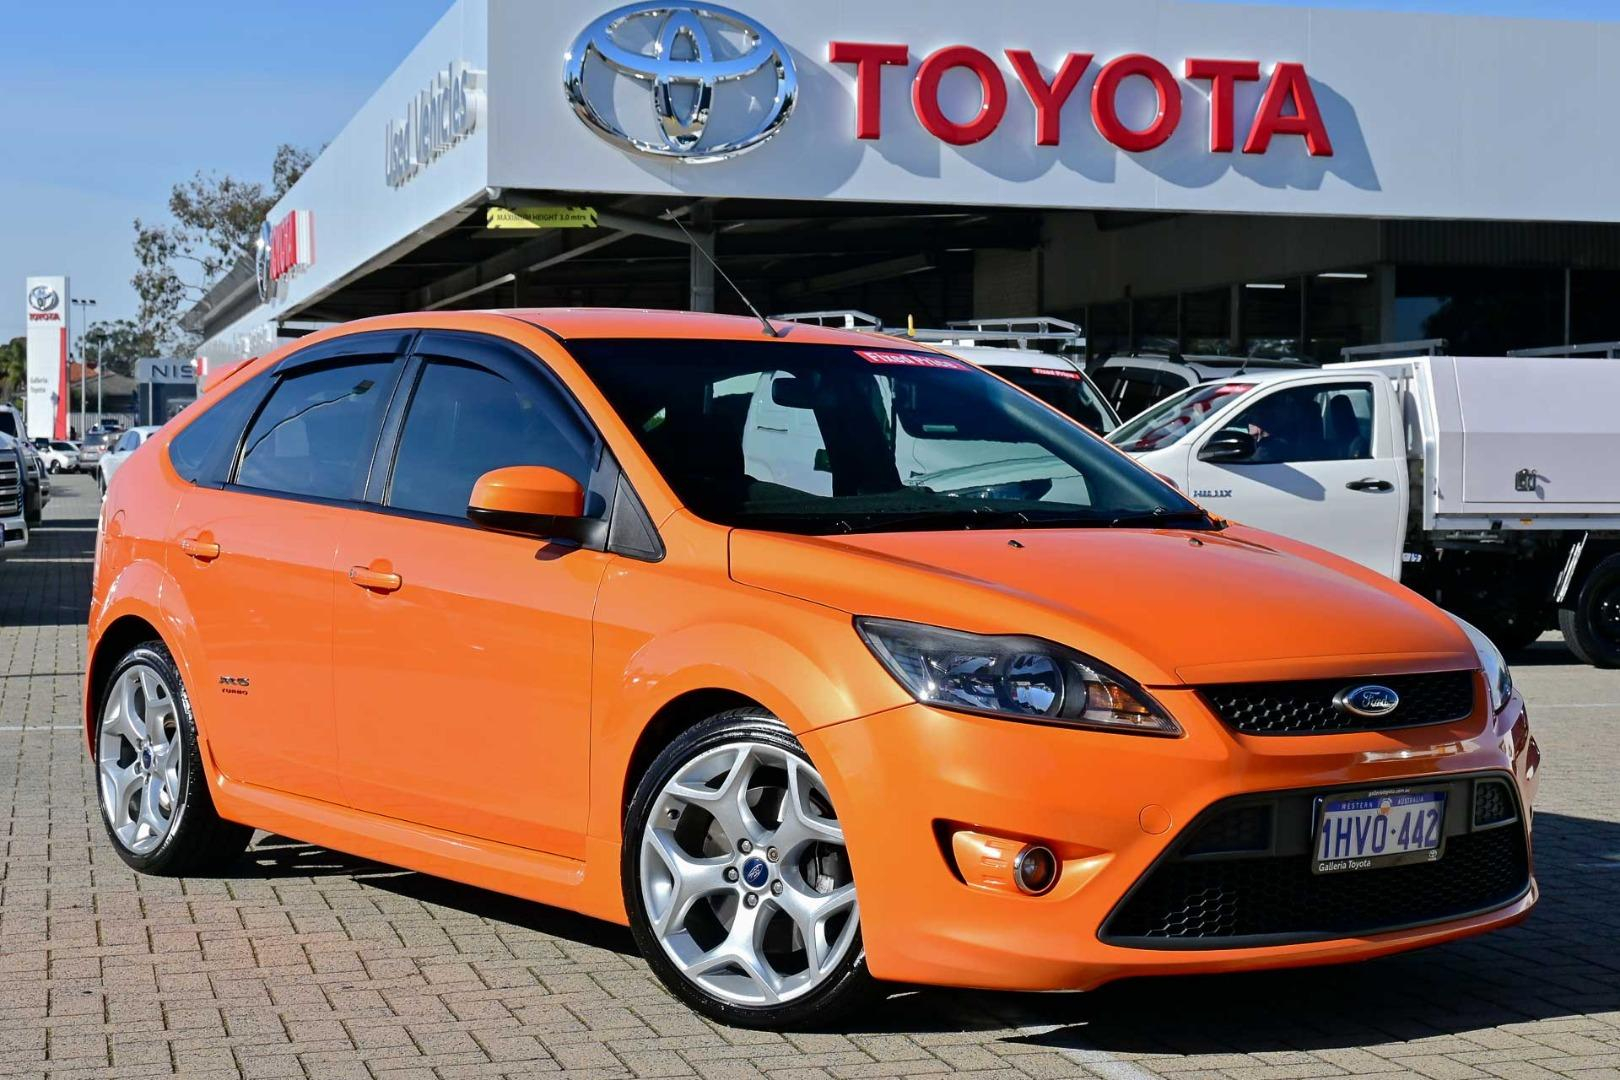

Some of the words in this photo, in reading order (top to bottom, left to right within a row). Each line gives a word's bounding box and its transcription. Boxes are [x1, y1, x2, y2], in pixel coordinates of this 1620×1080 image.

[828, 41, 1333, 157] TOYOTA
[385, 101, 411, 187] Used
[414, 62, 467, 164] Vehicles
[29, 313, 61, 321] TOYOTA
[864, 351, 913, 364] Fixed
[911, 355, 959, 369] Price
[1361, 691, 1390, 708] Ford
[1341, 801, 1374, 810] WESTERN
[1397, 796, 1424, 805] AUSTRALIA
[1318, 861, 1347, 872] Galleria
[1348, 859, 1371, 870] Toyota
